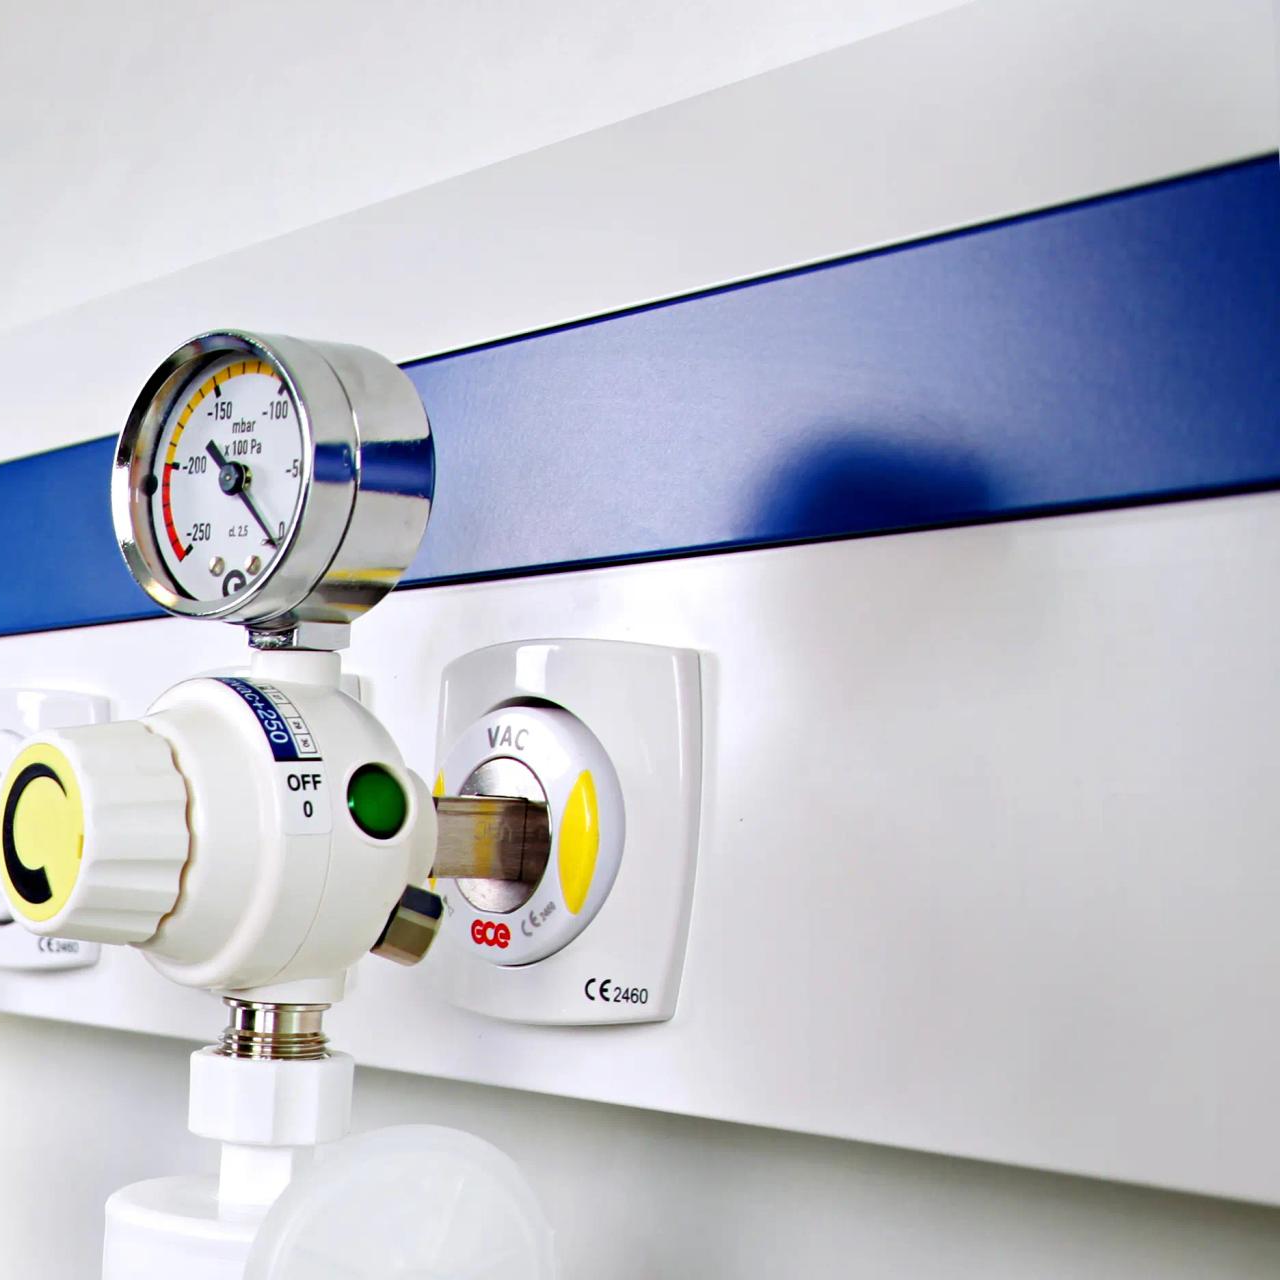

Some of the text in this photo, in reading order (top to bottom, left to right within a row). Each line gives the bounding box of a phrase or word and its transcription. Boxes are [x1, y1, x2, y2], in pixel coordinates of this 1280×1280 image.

[207, 402, 233, 420] -150
[262, 400, 289, 420] -100
[232, 418, 256, 434] mbar
[233, 440, 248, 455] 100
[250, 439, 262, 454] Pa
[182, 456, 207, 475] -200
[286, 459, 302, 478] -5
[186, 523, 211, 541] -250
[487, 725, 528, 750] VAC
[287, 774, 322, 791] OFF
[303, 800, 313, 818] 0
[613, 987, 649, 1005] 2460
